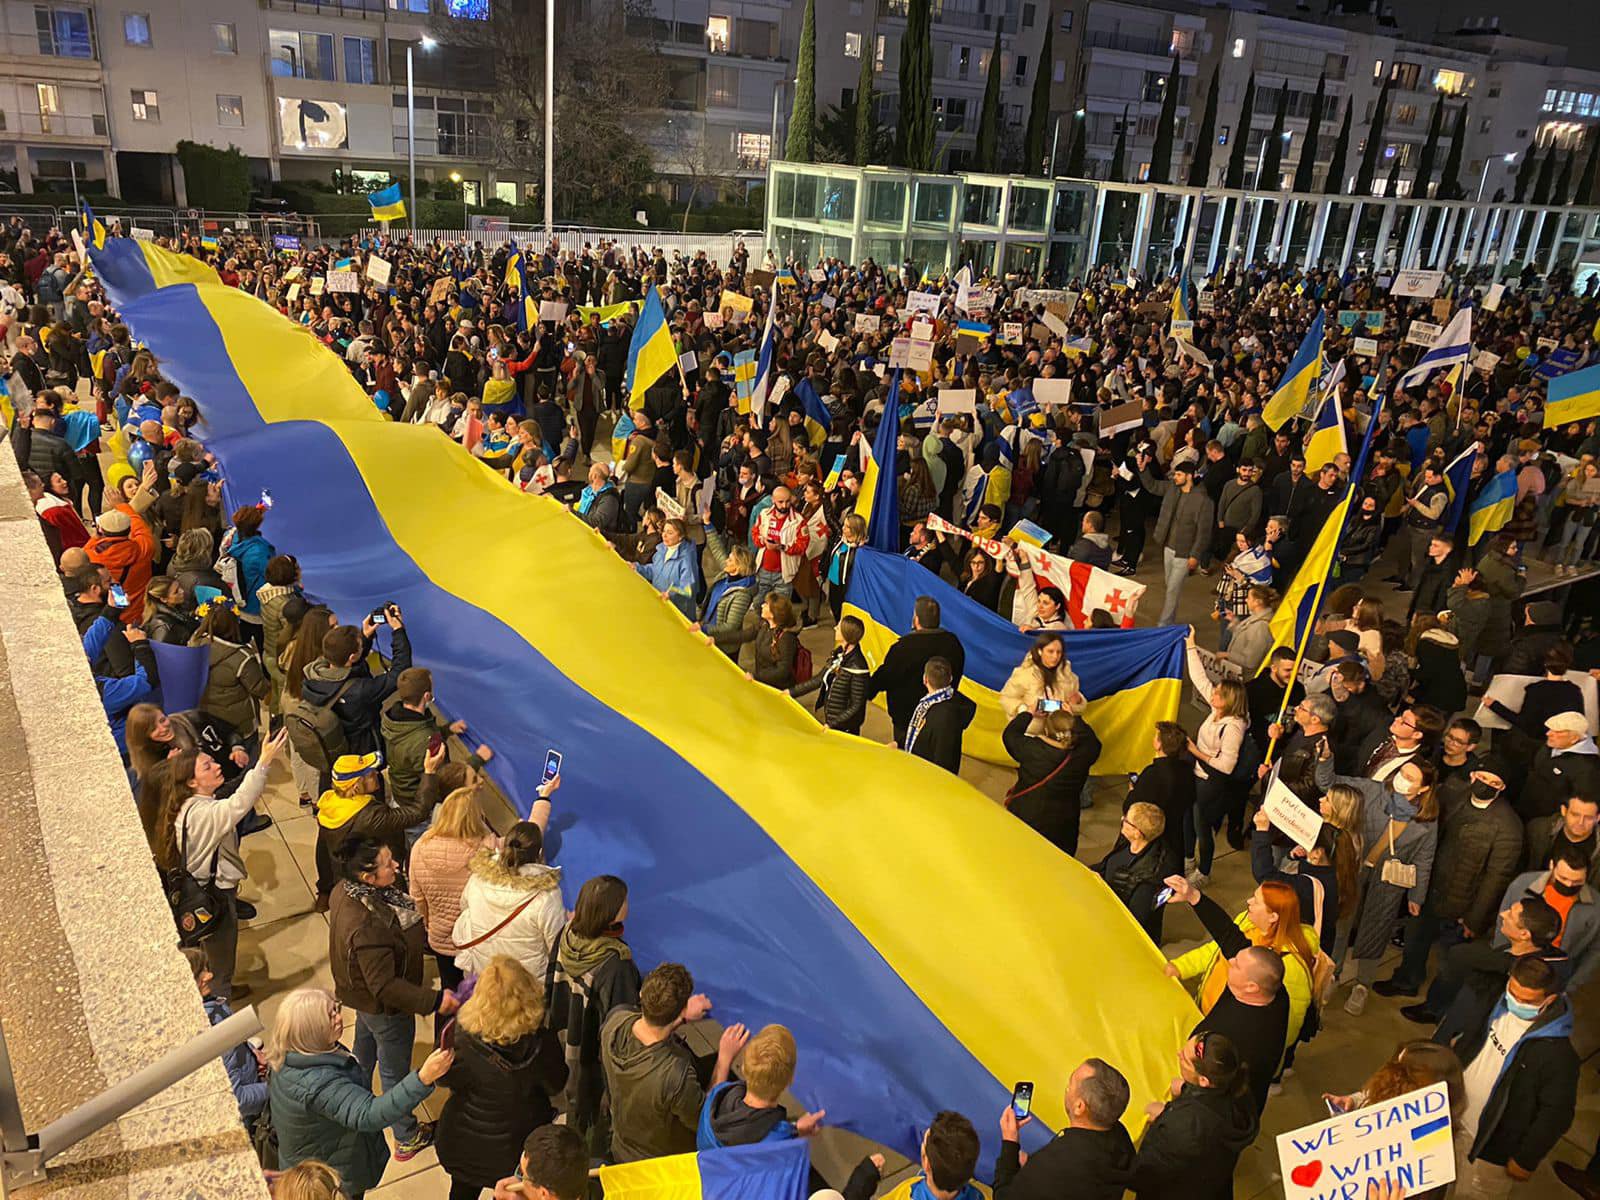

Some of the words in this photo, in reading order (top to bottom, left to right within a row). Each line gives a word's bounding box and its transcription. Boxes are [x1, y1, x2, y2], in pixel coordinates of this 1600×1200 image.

[1291, 1124, 1344, 1154] WE
[1354, 1091, 1446, 1138] STAND
[1309, 1154, 1435, 1200] RAINE
[1330, 1143, 1402, 1181] WITH
